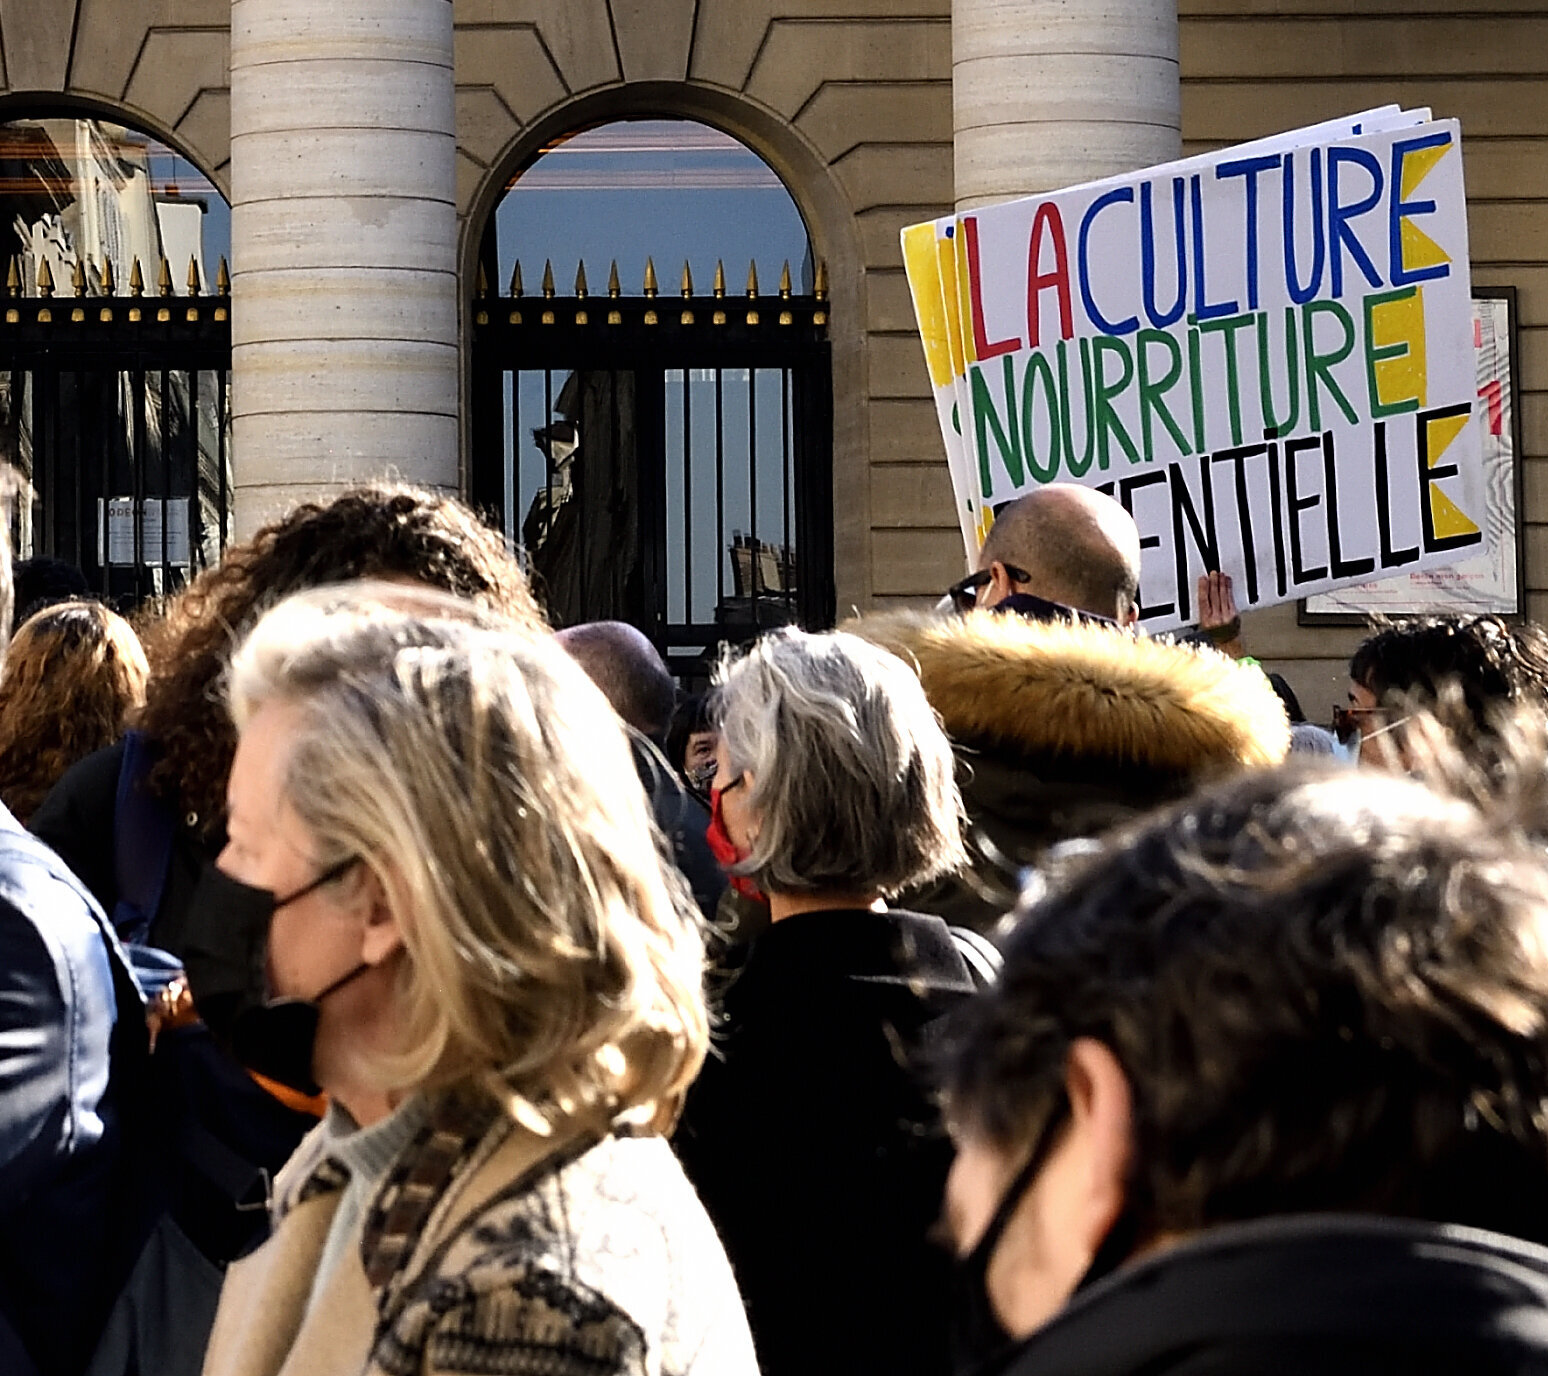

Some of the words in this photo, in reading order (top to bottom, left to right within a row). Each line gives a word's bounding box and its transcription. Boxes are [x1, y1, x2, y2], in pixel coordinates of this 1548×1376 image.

[964, 201, 1074, 362] LA
[1076, 131, 1452, 336] CULTURE
[1102, 402, 1482, 621] ENTIELLE
